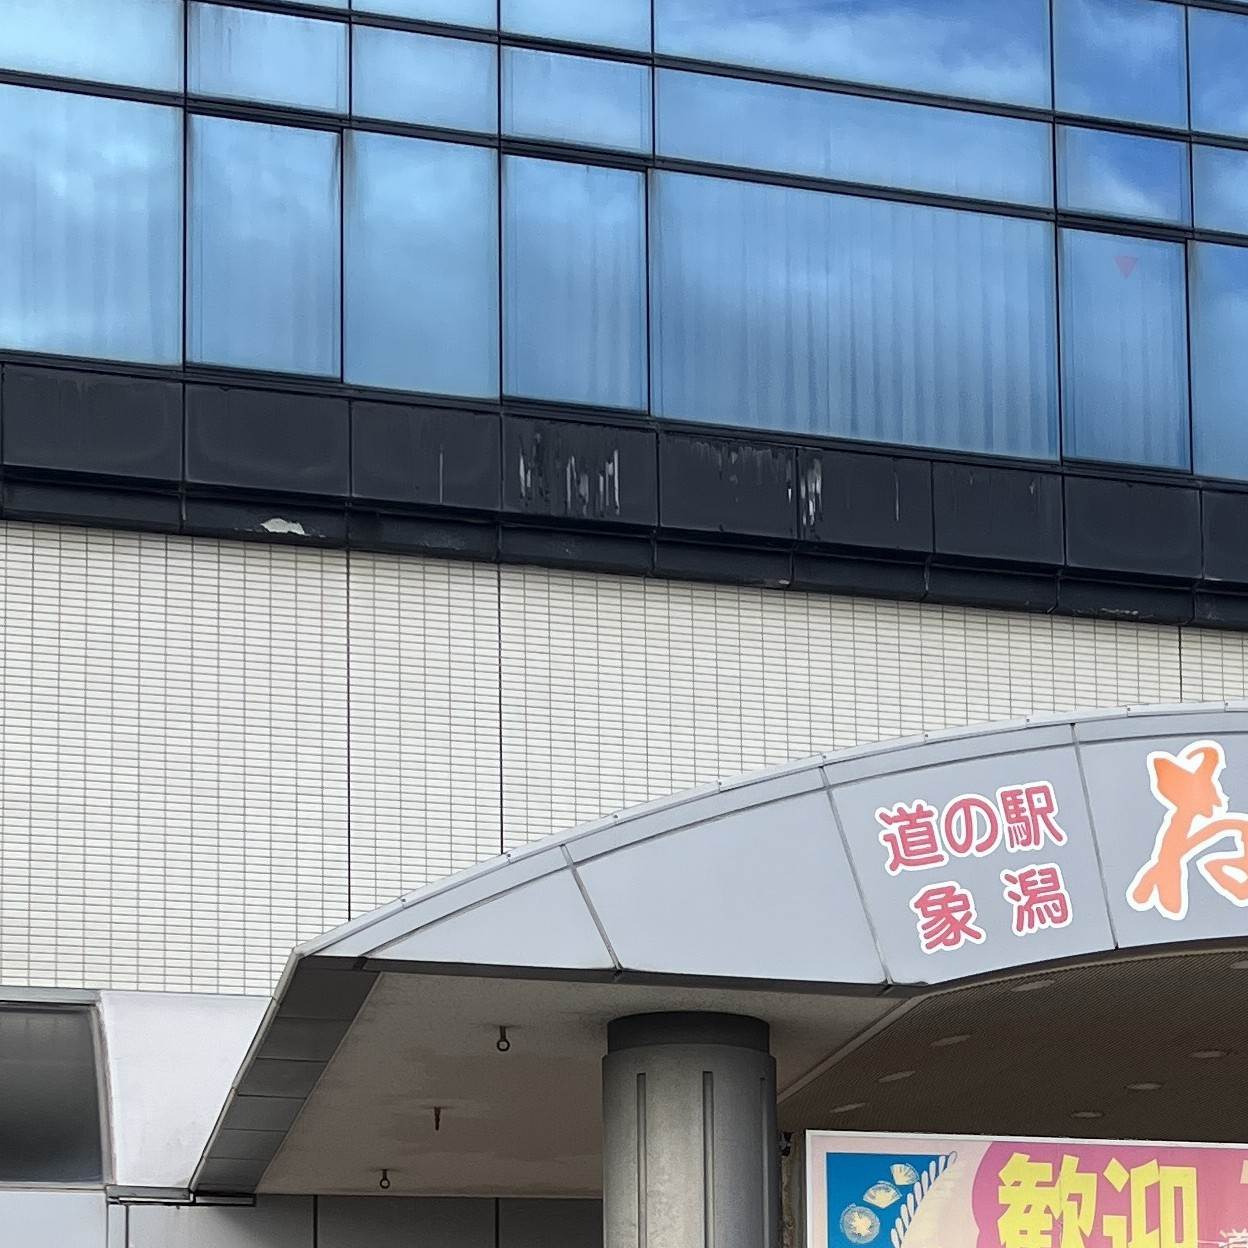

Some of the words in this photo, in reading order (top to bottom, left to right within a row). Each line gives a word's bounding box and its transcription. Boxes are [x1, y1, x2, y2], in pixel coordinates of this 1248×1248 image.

[880, 785, 1065, 872] 道の駅
[916, 868, 1069, 950] 象潟
